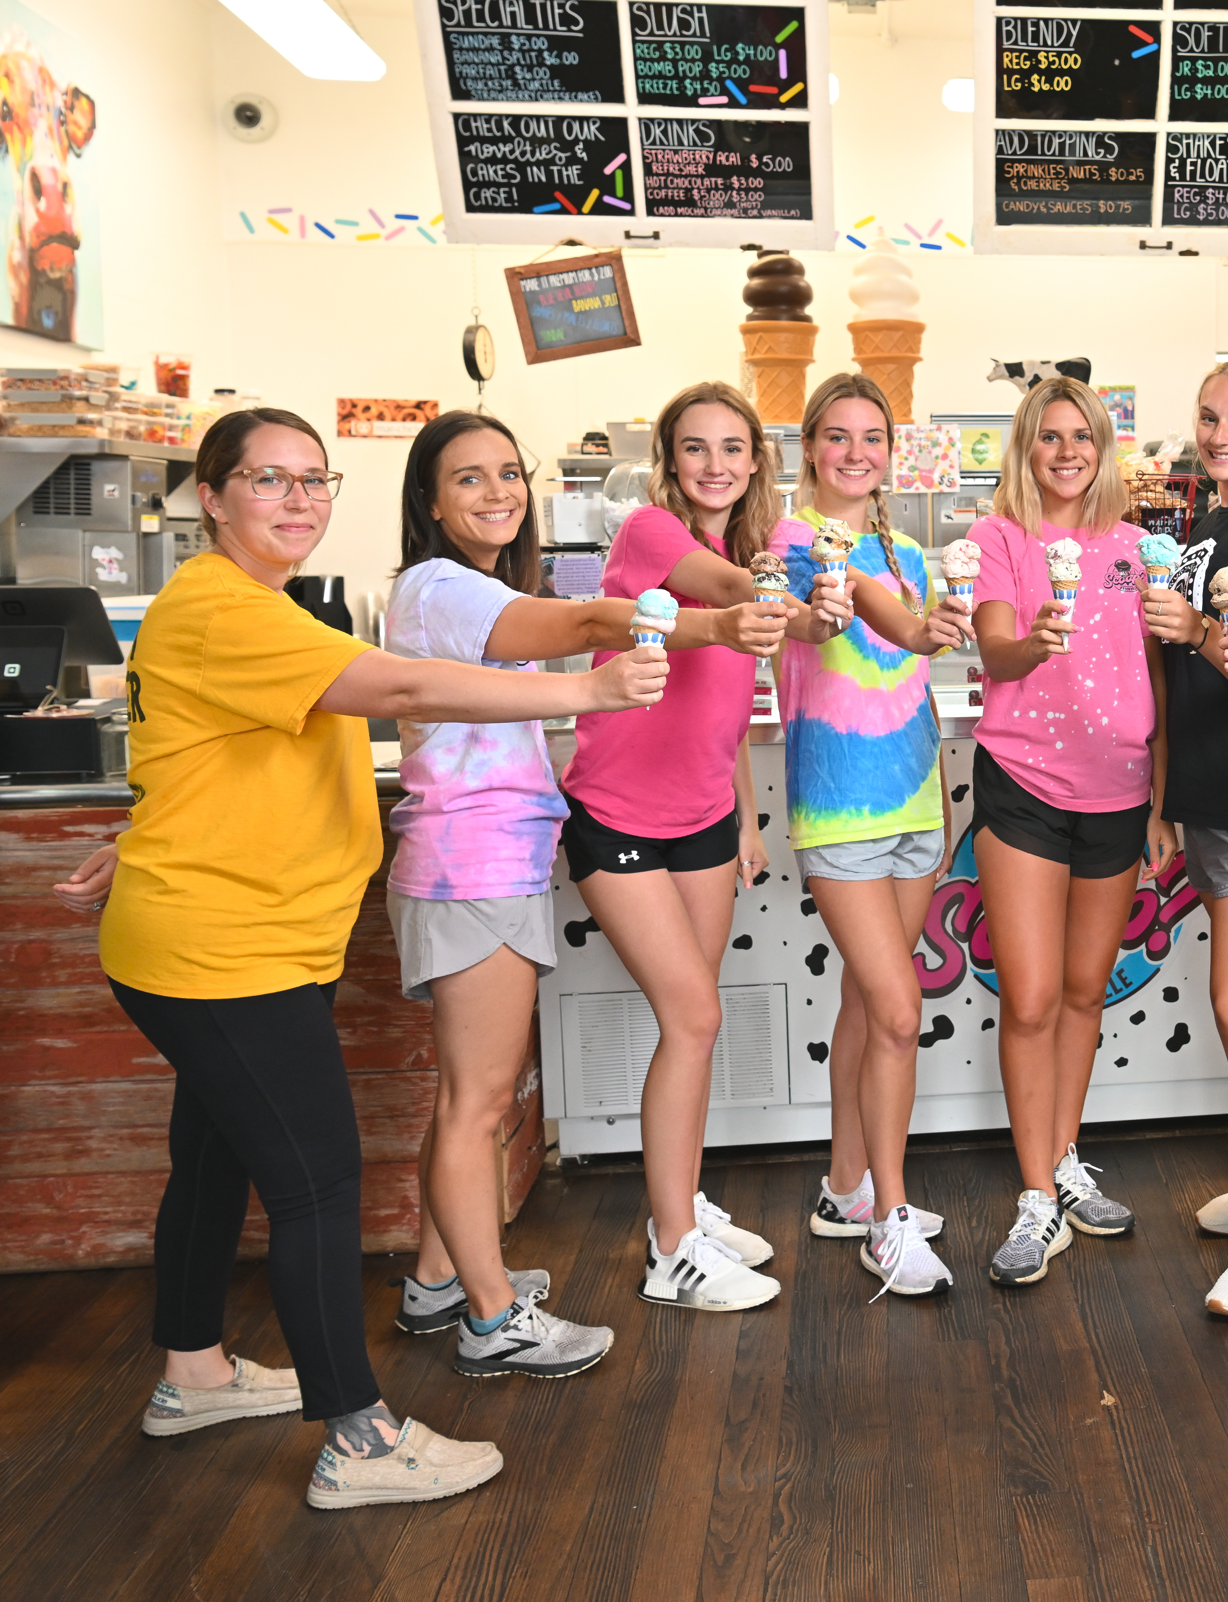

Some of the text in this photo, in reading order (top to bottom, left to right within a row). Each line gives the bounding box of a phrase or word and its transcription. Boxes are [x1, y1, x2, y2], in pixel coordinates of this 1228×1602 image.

[441, 0, 584, 31] SPECIALTIES
[632, 3, 711, 37] SLUSH
[510, 34, 548, 50] $5.00
[1002, 18, 1082, 48] BLENDY
[1176, 22, 1228, 53] SOFT
[452, 50, 502, 64] BANANA
[543, 51, 579, 65] $6.00
[663, 42, 702, 59] $3.00
[735, 42, 776, 61] $4.00
[1037, 51, 1082, 70] $5.00
[513, 65, 550, 80] $6.00
[636, 61, 675, 76] BOMB
[708, 62, 750, 79] $5.00
[684, 79, 721, 97] $4.50
[1030, 73, 1072, 92] $6.00
[470, 90, 535, 101] STRAWBERRY
[458, 115, 605, 141] CHECK OUT OUR
[640, 119, 715, 147] DRINKS
[463, 137, 588, 165] novelties &
[995, 129, 1119, 159] ADD TOPPINGS
[643, 149, 714, 164] STRAWBERRY
[716, 152, 741, 166] ACAI
[466, 163, 584, 184] CAKES IN THE
[651, 163, 706, 175] REFRESHER
[1004, 162, 1068, 179] SPRINKLES,
[1108, 167, 1145, 182] $0.25
[1169, 158, 1180, 181] &
[645, 176, 667, 188] HOT
[731, 175, 764, 190] $3.00
[1009, 178, 1070, 192] & CHERRIES
[469, 186, 519, 207] CASE!
[697, 200, 761, 209] (ICED) (HOT)
[748, 208, 761, 217] OR
[761, 208, 800, 218] VANILLA)
[1002, 200, 1040, 213] CANDY
[1098, 200, 1132, 214] $0.75
[572, 292, 619, 312] BANANA SPLIT
